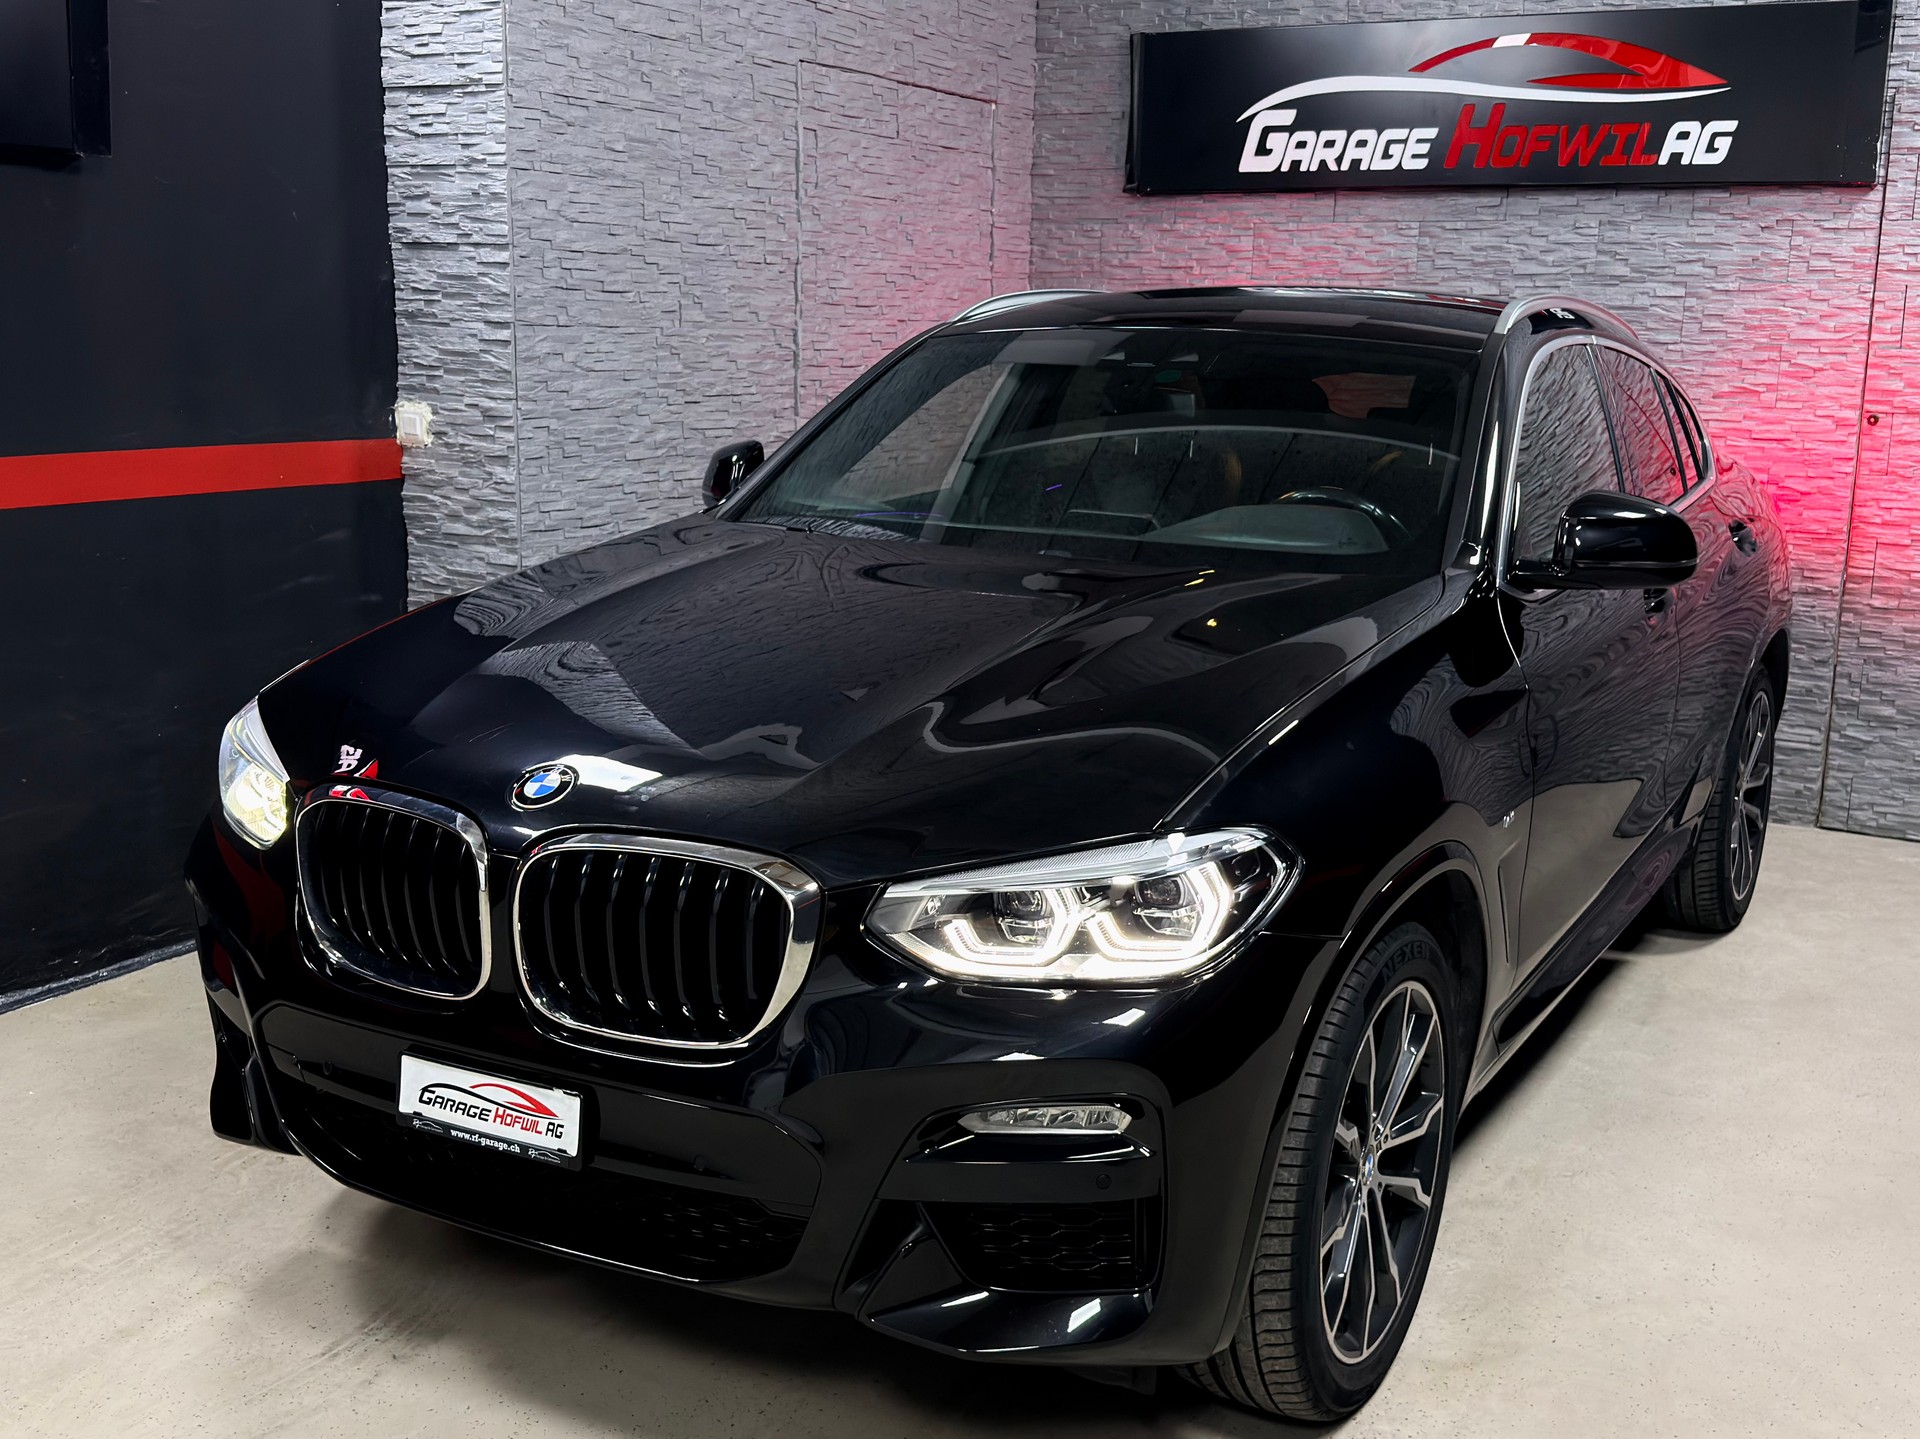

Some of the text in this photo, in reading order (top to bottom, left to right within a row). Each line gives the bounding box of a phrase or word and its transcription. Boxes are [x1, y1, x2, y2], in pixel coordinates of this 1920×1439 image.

[1237, 109, 1440, 173] GARAGE
[1382, 941, 1430, 982] NEXEN
[418, 1089, 565, 1139] GARAGE HOFWIL AG
[450, 1129, 521, 1153] www.rf-garage.ch
